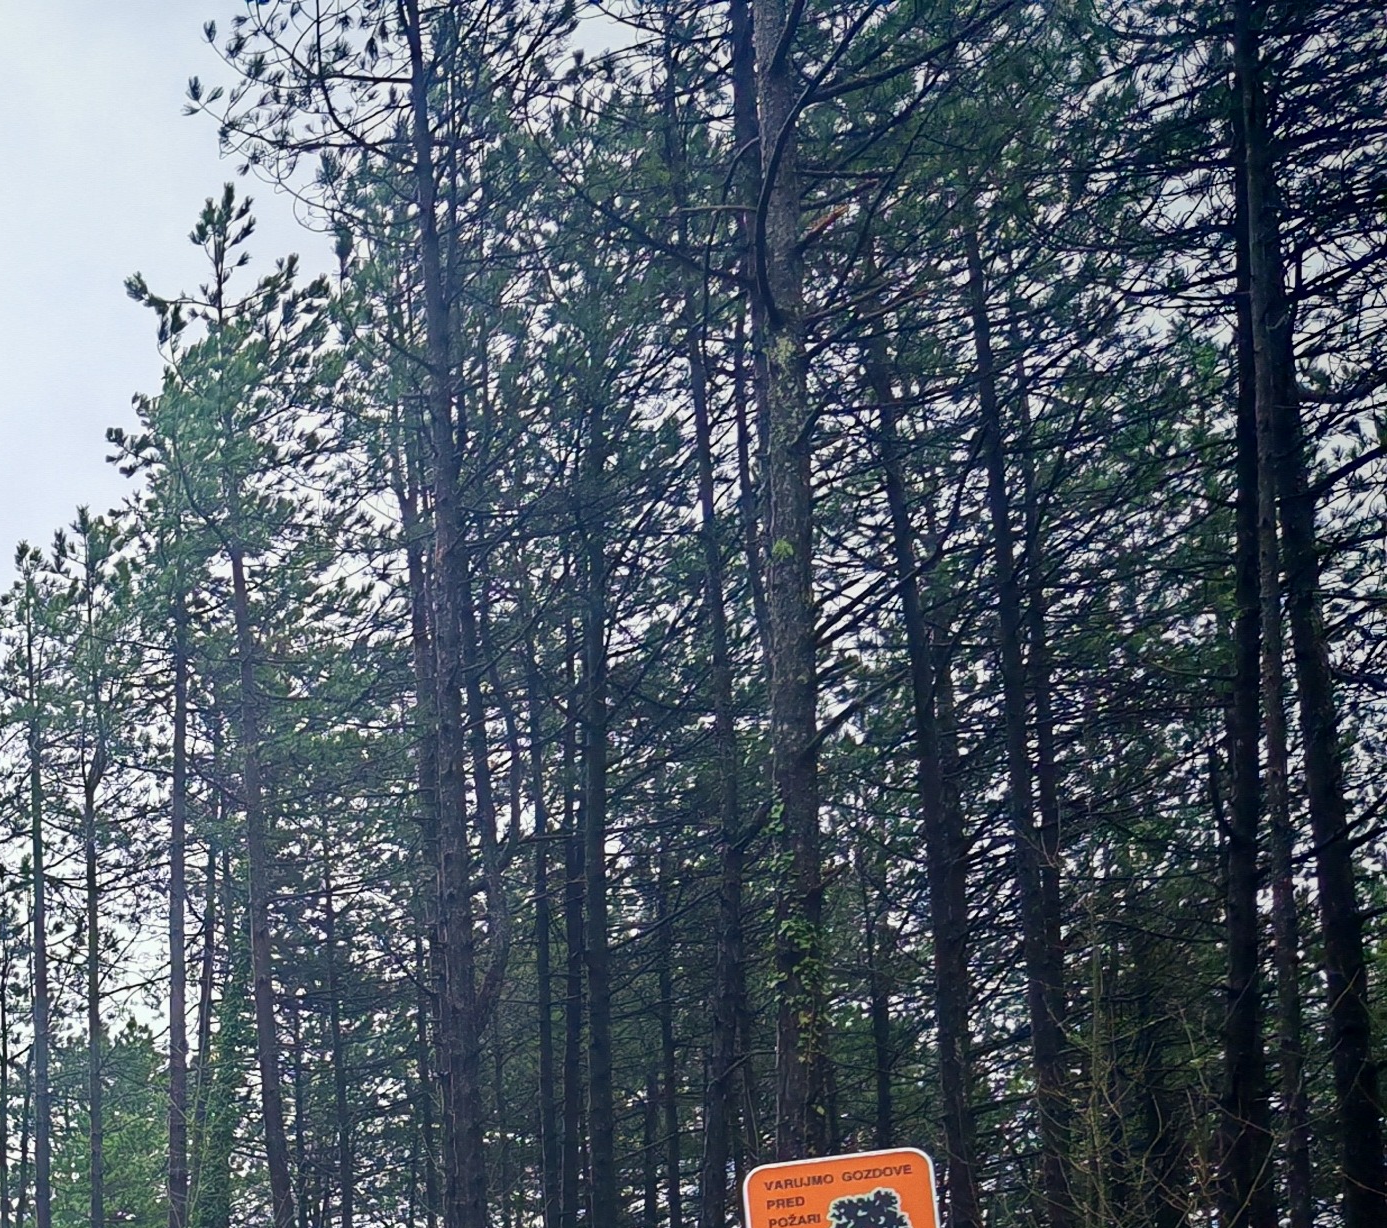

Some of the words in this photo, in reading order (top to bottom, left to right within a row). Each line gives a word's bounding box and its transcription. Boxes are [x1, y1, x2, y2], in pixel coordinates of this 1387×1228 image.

[764, 1174, 834, 1191] VARUJMO
[842, 1164, 912, 1182] GOZDOVE
[767, 1196, 805, 1210] PRED
[769, 1214, 821, 1228] POŽARI
